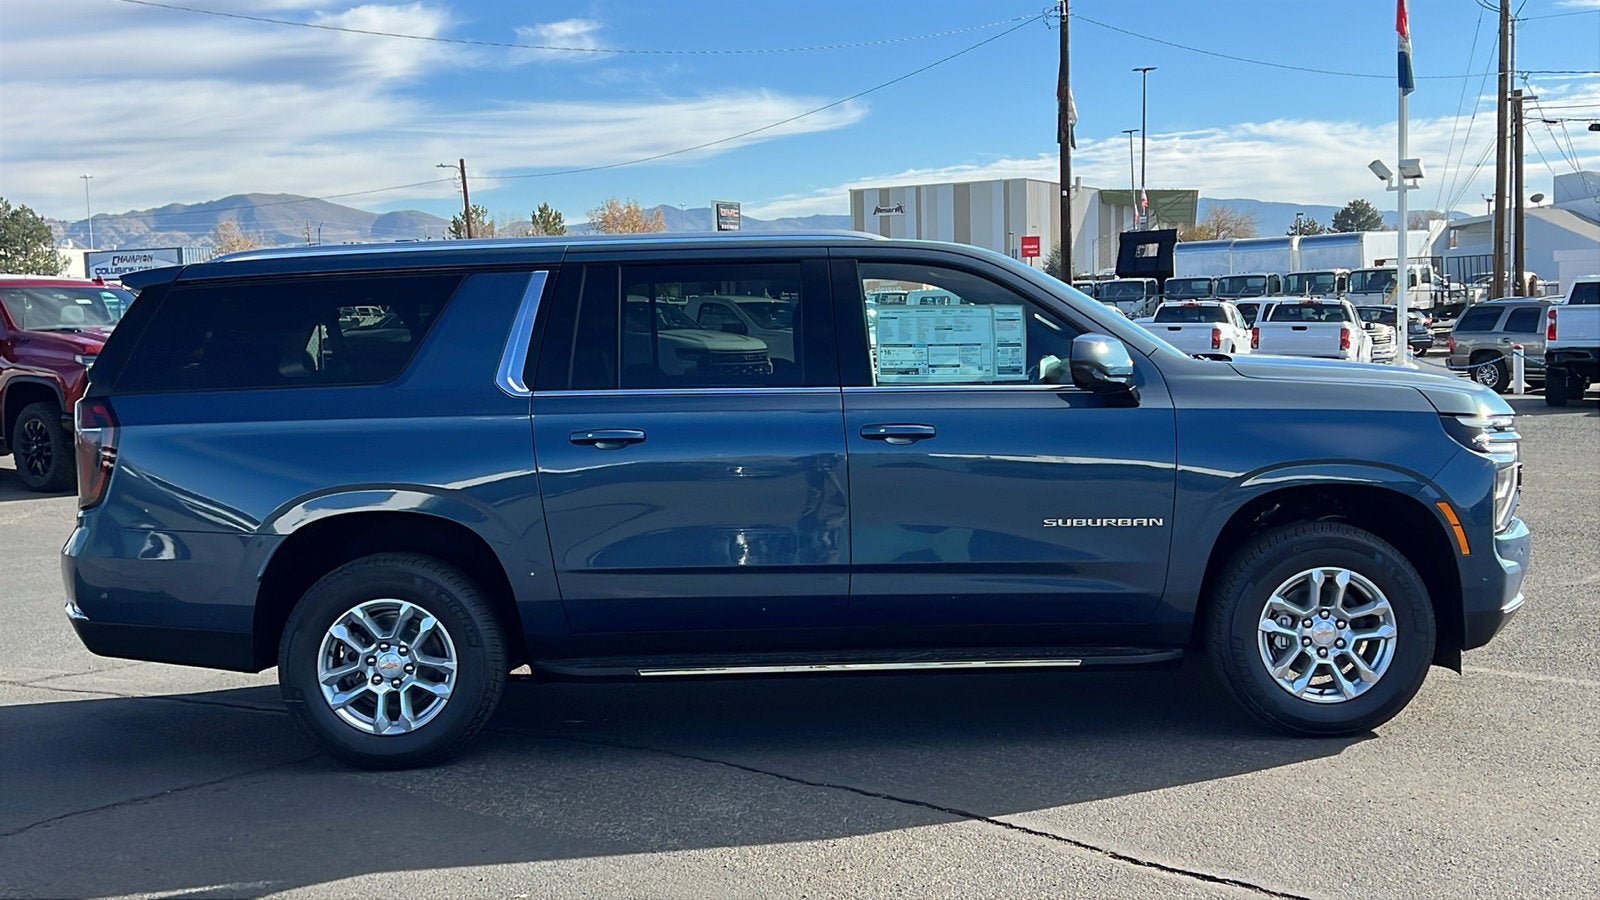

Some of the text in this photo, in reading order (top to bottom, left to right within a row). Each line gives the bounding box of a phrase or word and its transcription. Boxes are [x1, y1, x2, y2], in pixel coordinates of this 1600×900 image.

[112, 254, 153, 266] CHAMPION
[94, 265, 137, 275] COLLISION
[1043, 518, 1164, 527] SUBURBAN
